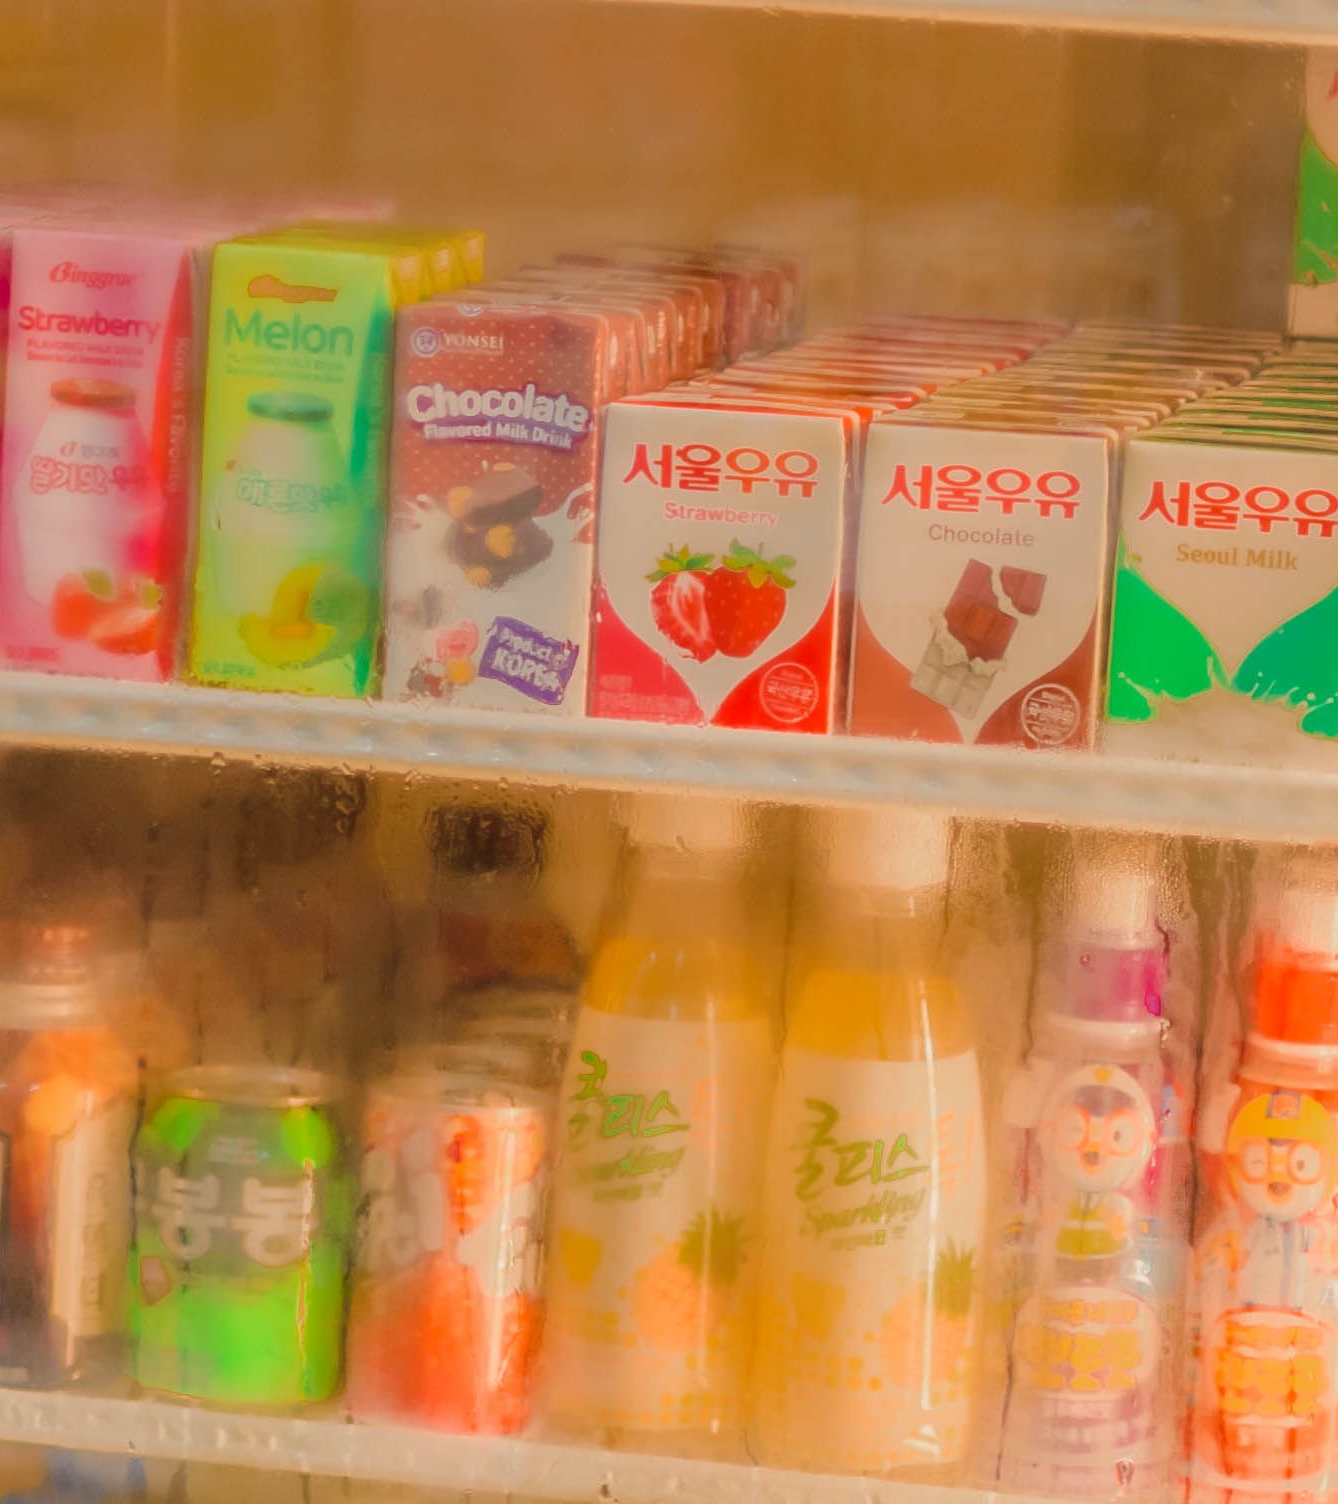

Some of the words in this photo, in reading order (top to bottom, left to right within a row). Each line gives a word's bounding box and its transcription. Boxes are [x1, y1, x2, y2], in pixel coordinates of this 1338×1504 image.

[18, 305, 161, 344] Strawberry
[224, 307, 355, 357] Melon
[444, 332, 504, 350] YONSEI
[407, 383, 589, 433] Chocolate
[424, 423, 491, 440] Flavored
[495, 421, 529, 440] Milk
[532, 427, 573, 450] Drink
[622, 443, 820, 499] 서울우유
[880, 464, 1082, 519] 서울우유
[663, 501, 779, 528] Strawberry
[927, 523, 1036, 548] Chocolate
[1175, 543, 1239, 567] Seoul
[1245, 548, 1299, 571] Milk
